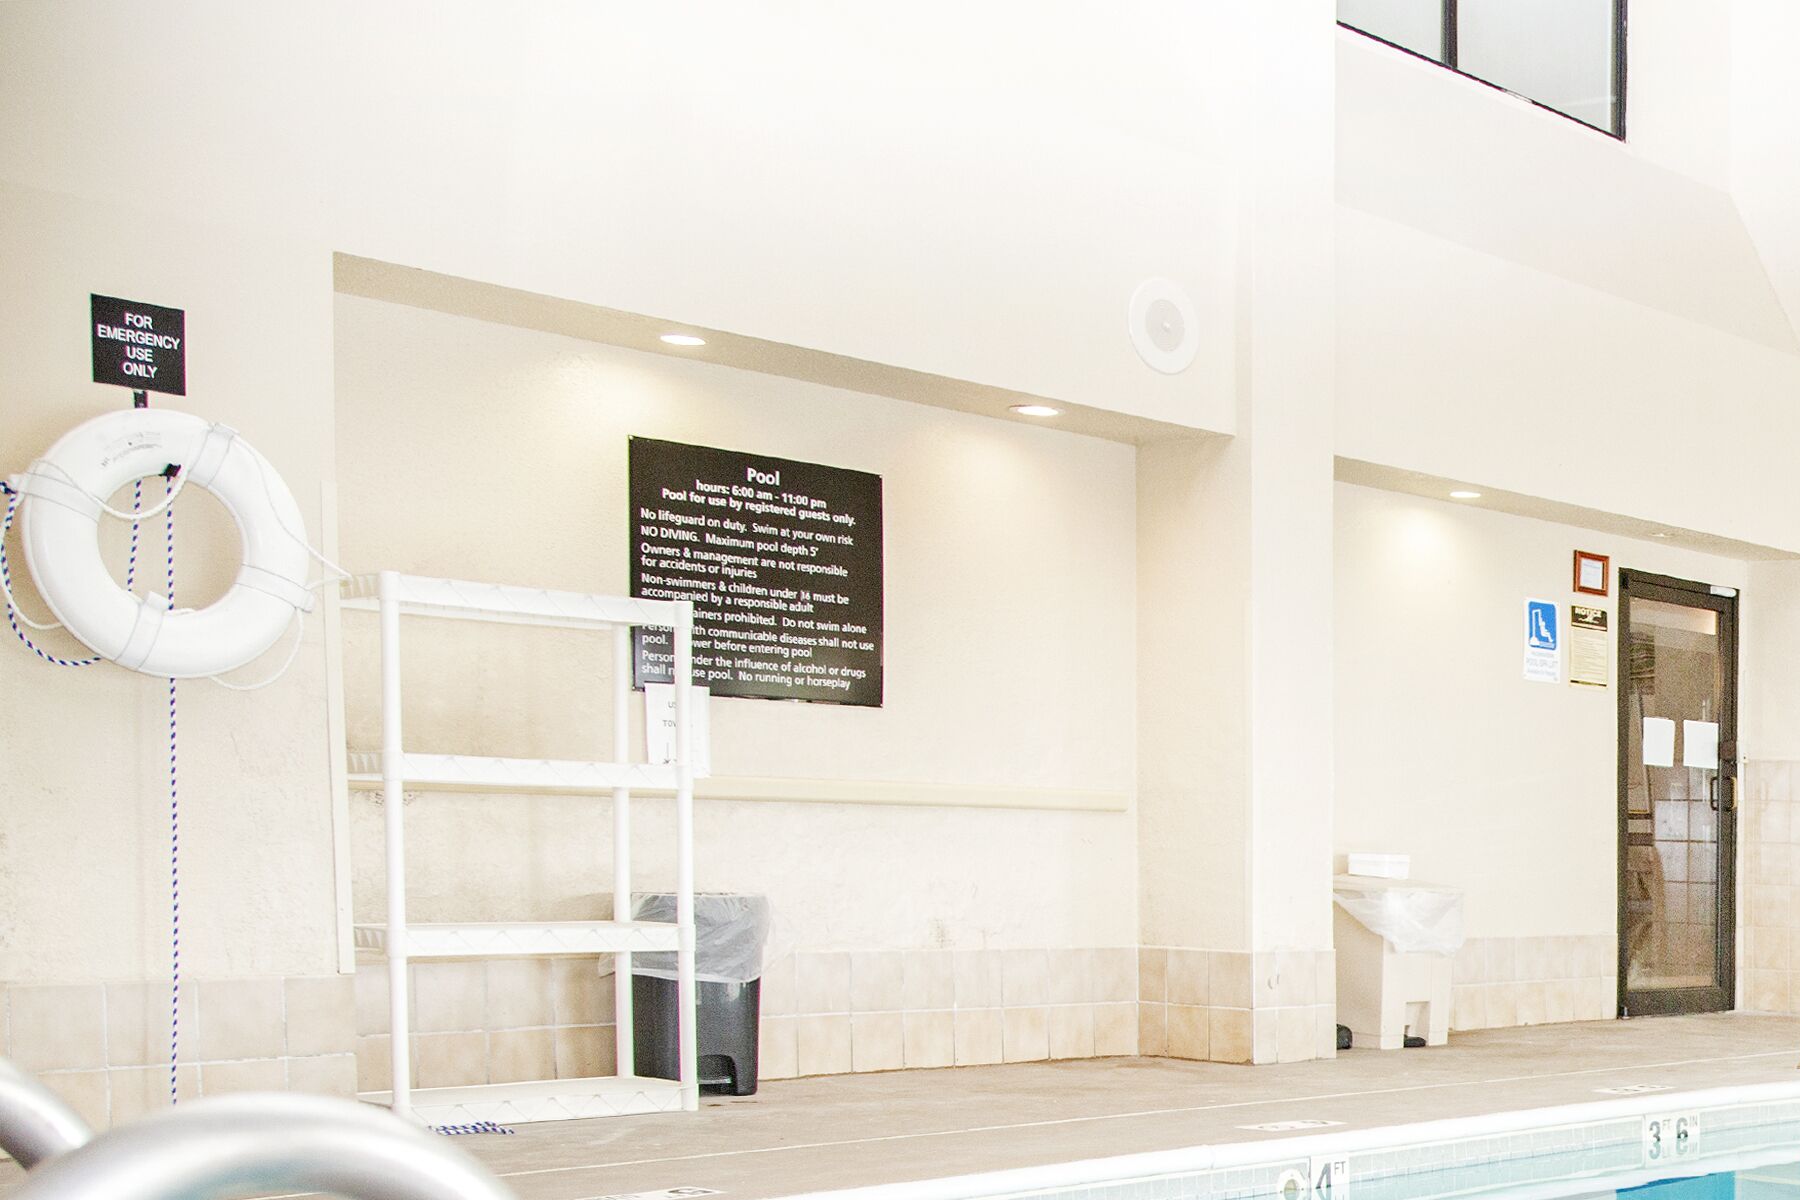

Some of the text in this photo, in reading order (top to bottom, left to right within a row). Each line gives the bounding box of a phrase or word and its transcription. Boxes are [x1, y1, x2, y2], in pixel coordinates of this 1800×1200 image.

[125, 312, 153, 329] FOR
[97, 324, 180, 350] EMERGENCY
[126, 345, 153, 362] USE
[122, 361, 158, 379] ONLY
[746, 467, 780, 486] Pool
[695, 479, 730, 494] hours:
[731, 485, 754, 498] 6:00
[756, 490, 773, 500] am
[782, 493, 809, 506] 11:00
[810, 499, 827, 510] pm
[661, 488, 856, 527] Pool for use by registered guests only.
[640, 507, 854, 546] No lifeguard on duty. Swim at your own risk
[640, 525, 658, 537] NO
[660, 527, 700, 542] DIVING.
[705, 532, 755, 549] Maximum
[756, 541, 779, 553] pool
[780, 543, 809, 557] depth
[641, 542, 848, 577] Owners & management are not responsible
[641, 555, 758, 579] for accidents or injuries
[641, 572, 850, 605] Non-swimmers & children under 16 must be
[641, 587, 709, 602] accompanied
[711, 592, 724, 607] by
[733, 598, 788, 611] responsible
[789, 602, 815, 613] adult
[724, 612, 777, 627] prohibited.
[782, 617, 796, 628] Do
[798, 619, 815, 630] not
[816, 621, 840, 632] swim
[841, 623, 868, 634] alone
[642, 634, 668, 645] pool.
[714, 640, 747, 653] before
[748, 644, 790, 659] entering
[791, 647, 812, 659] pool
[707, 629, 778, 643] communicable
[780, 632, 817, 646] diseases
[818, 636, 840, 648] shall
[842, 640, 858, 650] not
[859, 642, 875, 651] use
[641, 662, 666, 675] shall
[708, 669, 733, 681] pool.
[739, 670, 753, 681] No
[755, 673, 793, 687] running
[794, 677, 805, 685] or
[807, 676, 851, 691] horseplay
[715, 656, 732, 667] the
[734, 657, 778, 672] influence
[781, 661, 791, 672] of
[793, 662, 827, 674] alcohol
[828, 667, 839, 675] or
[840, 666, 866, 679] drugs
[1334, 1161, 1346, 1176] FT
